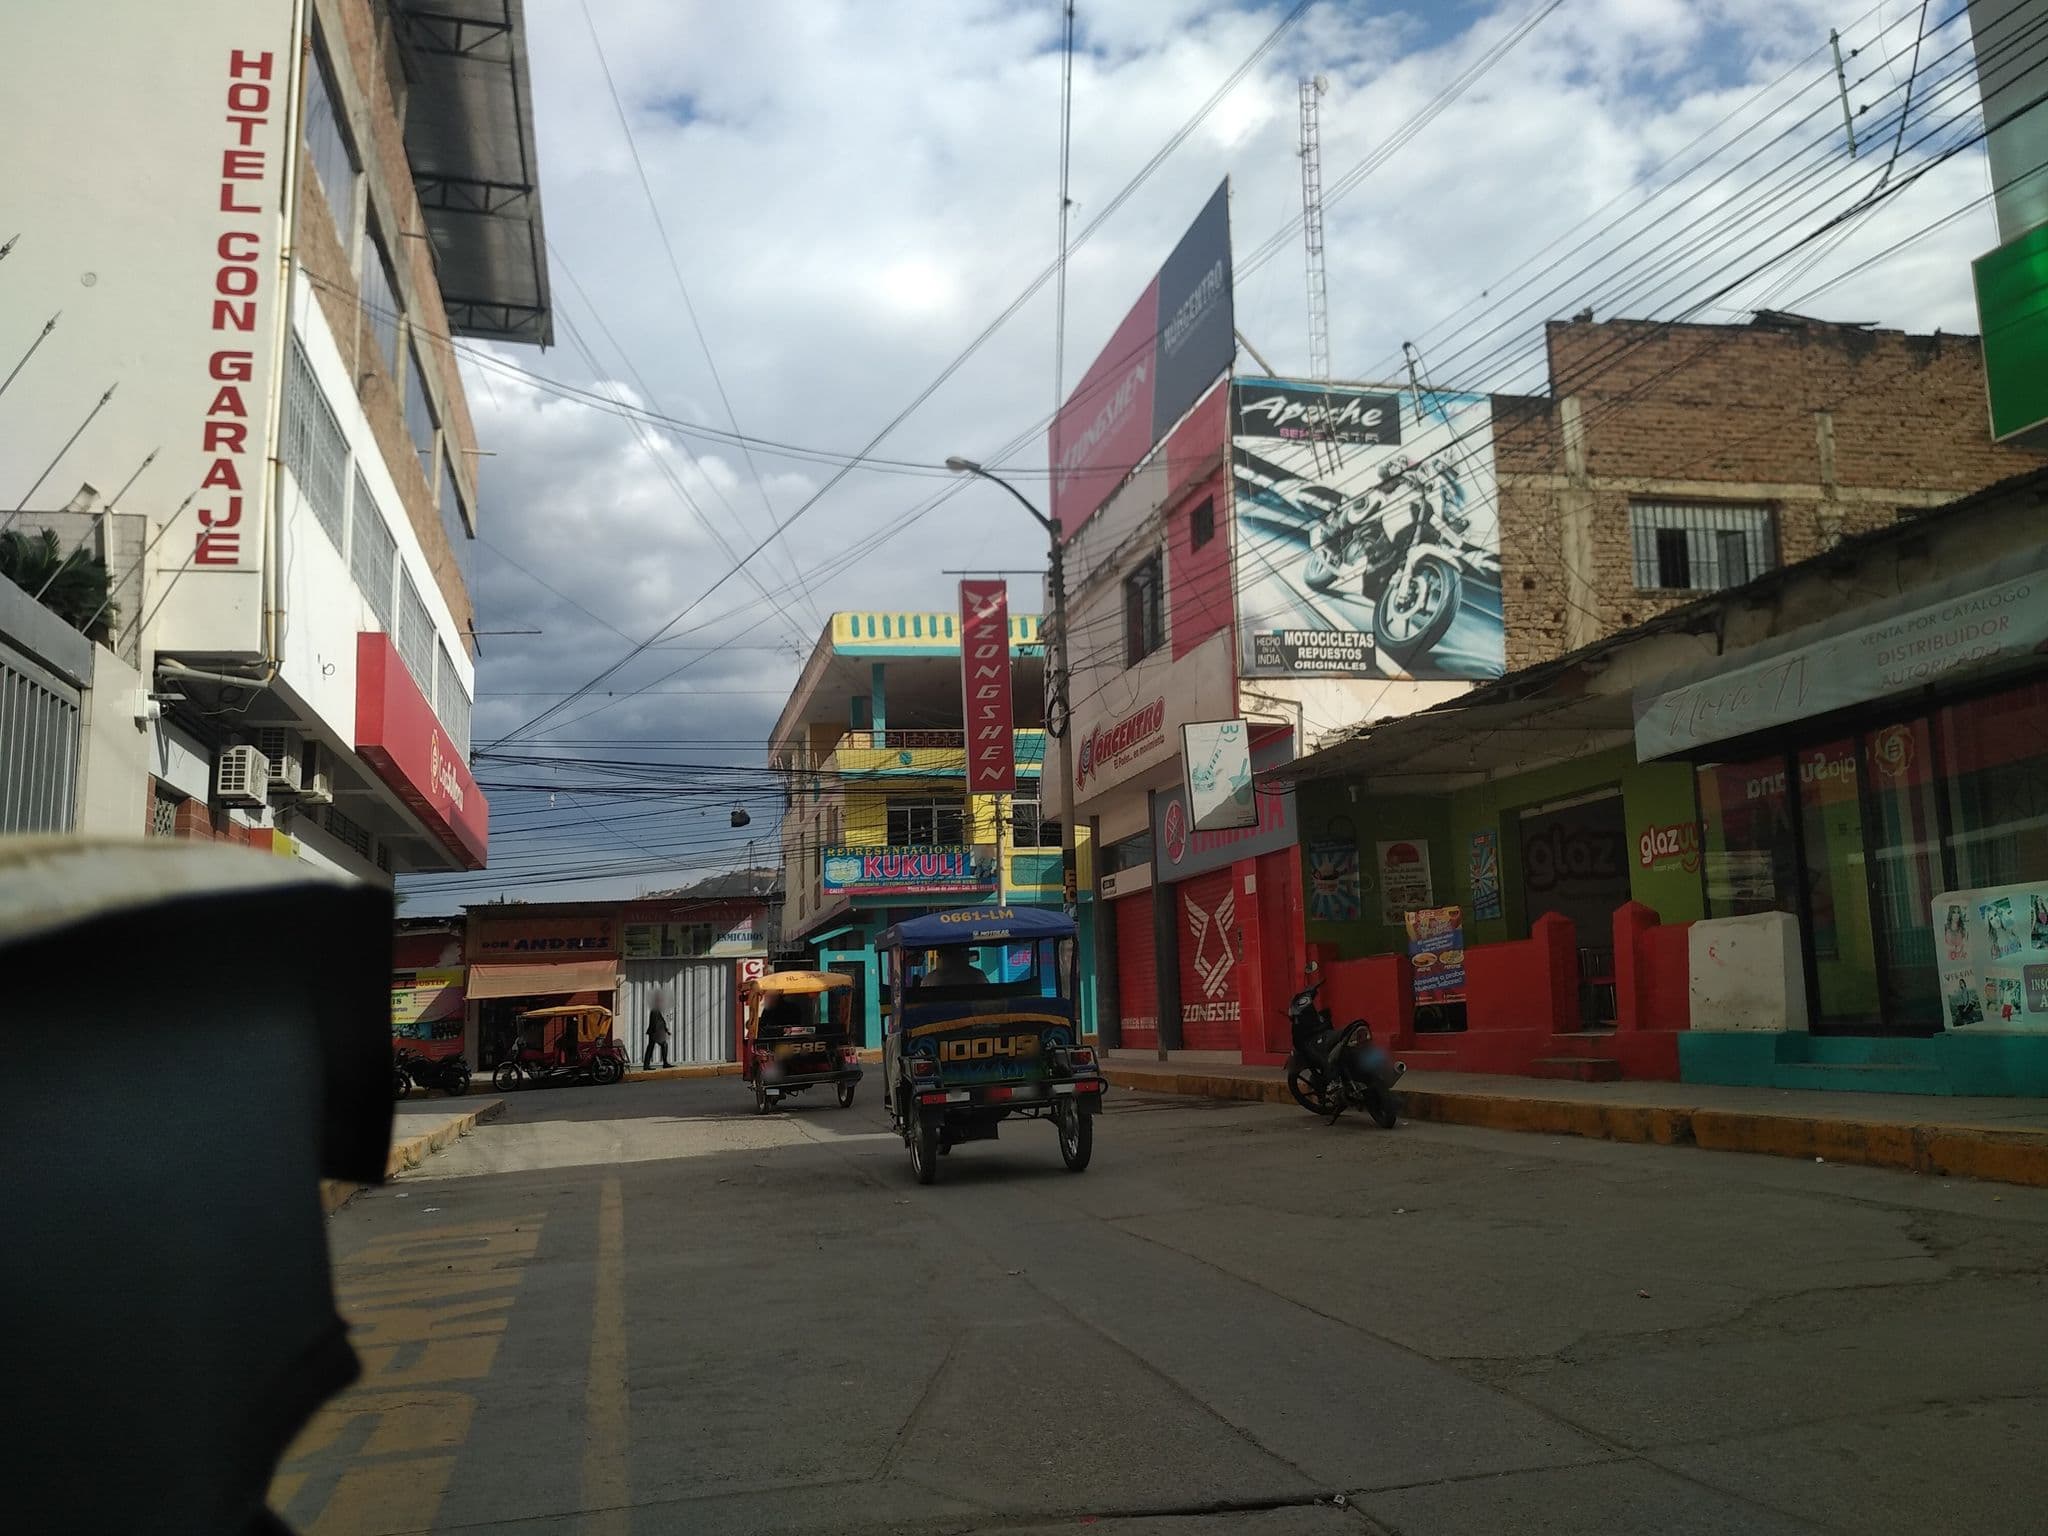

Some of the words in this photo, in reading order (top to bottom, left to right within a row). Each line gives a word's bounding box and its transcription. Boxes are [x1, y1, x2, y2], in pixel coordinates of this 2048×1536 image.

[220, 49, 273, 214] HOTEL
[212, 231, 259, 332] CON
[1240, 395, 1385, 428] Apache
[194, 350, 253, 566] GARAJE
[1284, 631, 1375, 648] MOTOCICLETAS
[1860, 624, 1902, 646] VENTA
[1907, 614, 1937, 635] POR
[1877, 615, 2010, 667] DISTRIBUIDOR
[1257, 654, 1281, 666] INDIA
[1294, 660, 1368, 671] ORIGINALES
[1297, 647, 1363, 661] REPUESTOS
[1881, 645, 2002, 689] AUTORIZADO
[974, 623, 1005, 783] ZONGSHEN
[827, 845, 970, 858] REPRESENTACIONES
[863, 854, 963, 878] KUKULI
[515, 936, 609, 952] ANDRES
[717, 932, 764, 942] ENMICADOS
